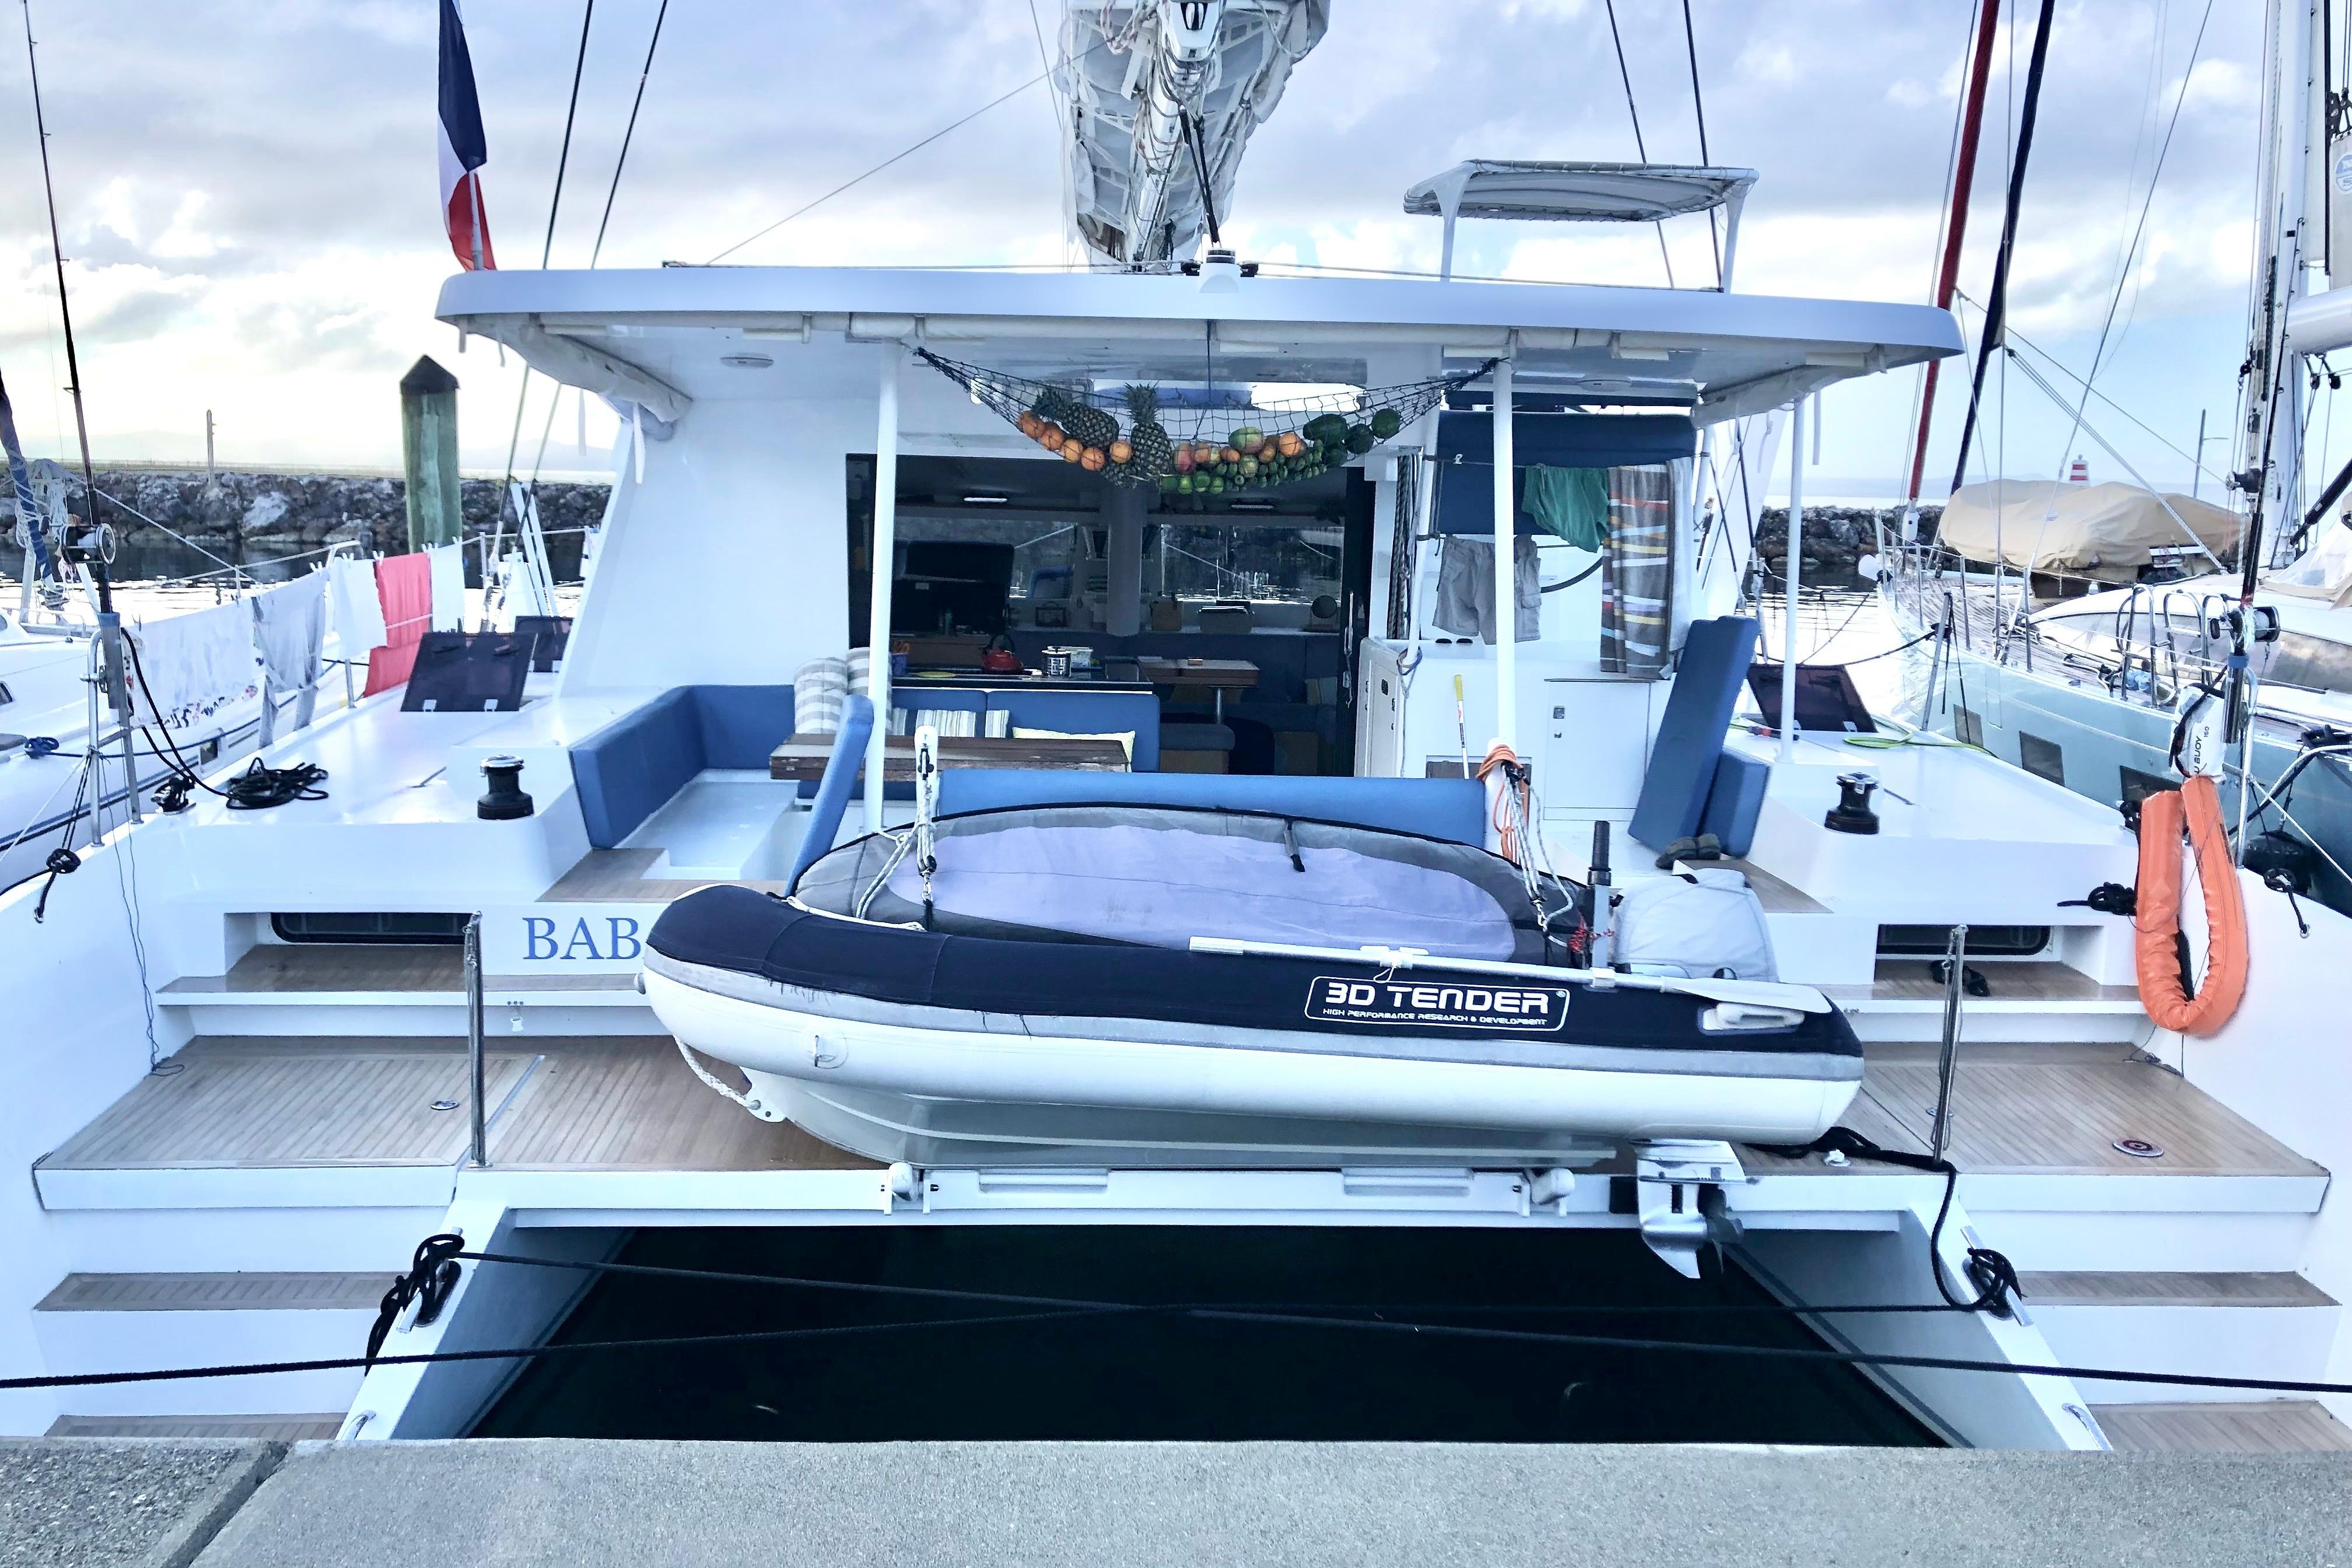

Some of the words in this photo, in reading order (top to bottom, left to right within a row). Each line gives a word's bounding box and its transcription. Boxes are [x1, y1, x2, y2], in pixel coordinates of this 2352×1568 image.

[2194, 736, 2202, 764] BUOY
[522, 917, 643, 960] BAB
[1325, 982, 1376, 1006] 3D
[1387, 985, 1549, 1014] TENDER
[1322, 1008, 1345, 1016] HIGH
[1347, 1010, 1416, 1020] PERFORMANCE
[1418, 1013, 1468, 1022] RESEARCH
[1479, 1016, 1548, 1026] DEVELOPMENT
